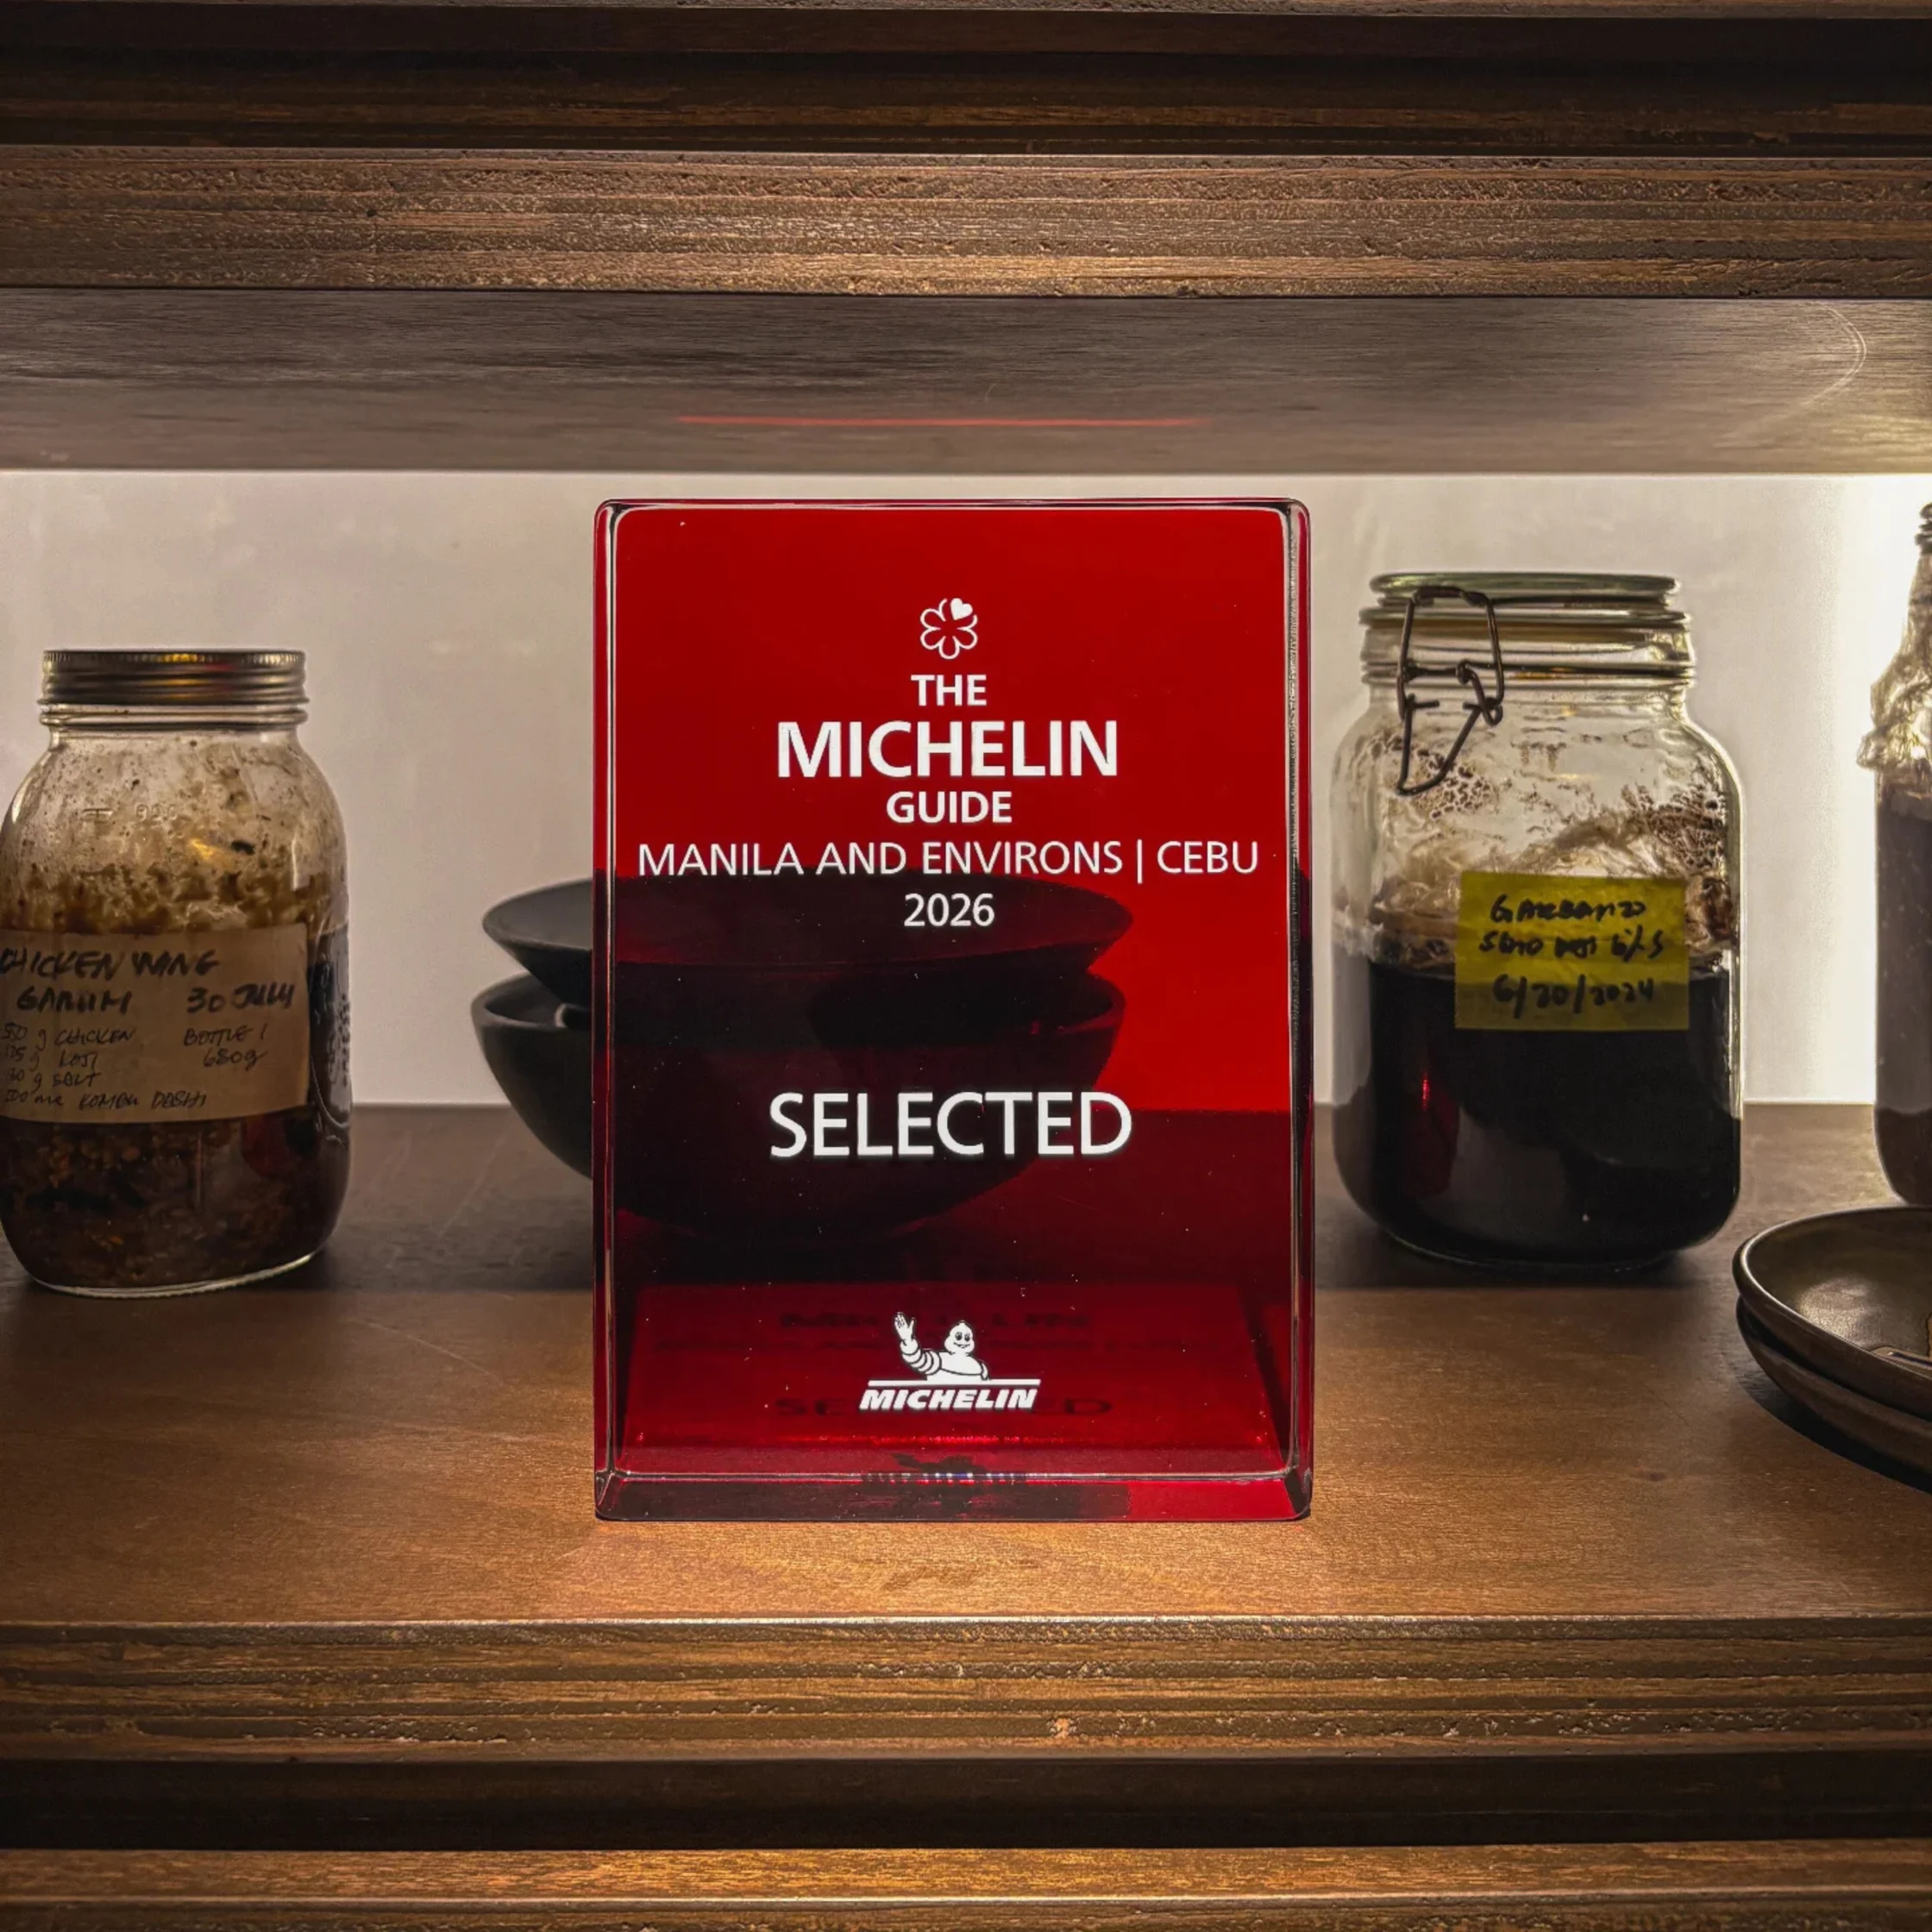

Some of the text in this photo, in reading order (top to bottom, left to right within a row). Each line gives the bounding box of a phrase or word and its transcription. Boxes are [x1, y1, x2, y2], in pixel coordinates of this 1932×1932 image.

[910, 674, 988, 706] THE
[778, 720, 1118, 778] MICHELIN
[886, 791, 1013, 824] GUIDE
[639, 843, 805, 876] MANILA
[815, 842, 906, 875] AND
[922, 840, 1123, 875] ENVIRONS
[1157, 840, 1258, 874] CEBU
[904, 893, 995, 927] 2026
[0, 947, 220, 982] CHICKEN WING
[16, 985, 133, 1014] GARUM
[186, 982, 296, 1013] 30 JULY
[54, 1026, 138, 1046] CHICKEN
[183, 1025, 254, 1047] BOTTLE
[769, 1091, 1133, 1158] SELECTED
[859, 1389, 1038, 1411] MICHELIN
